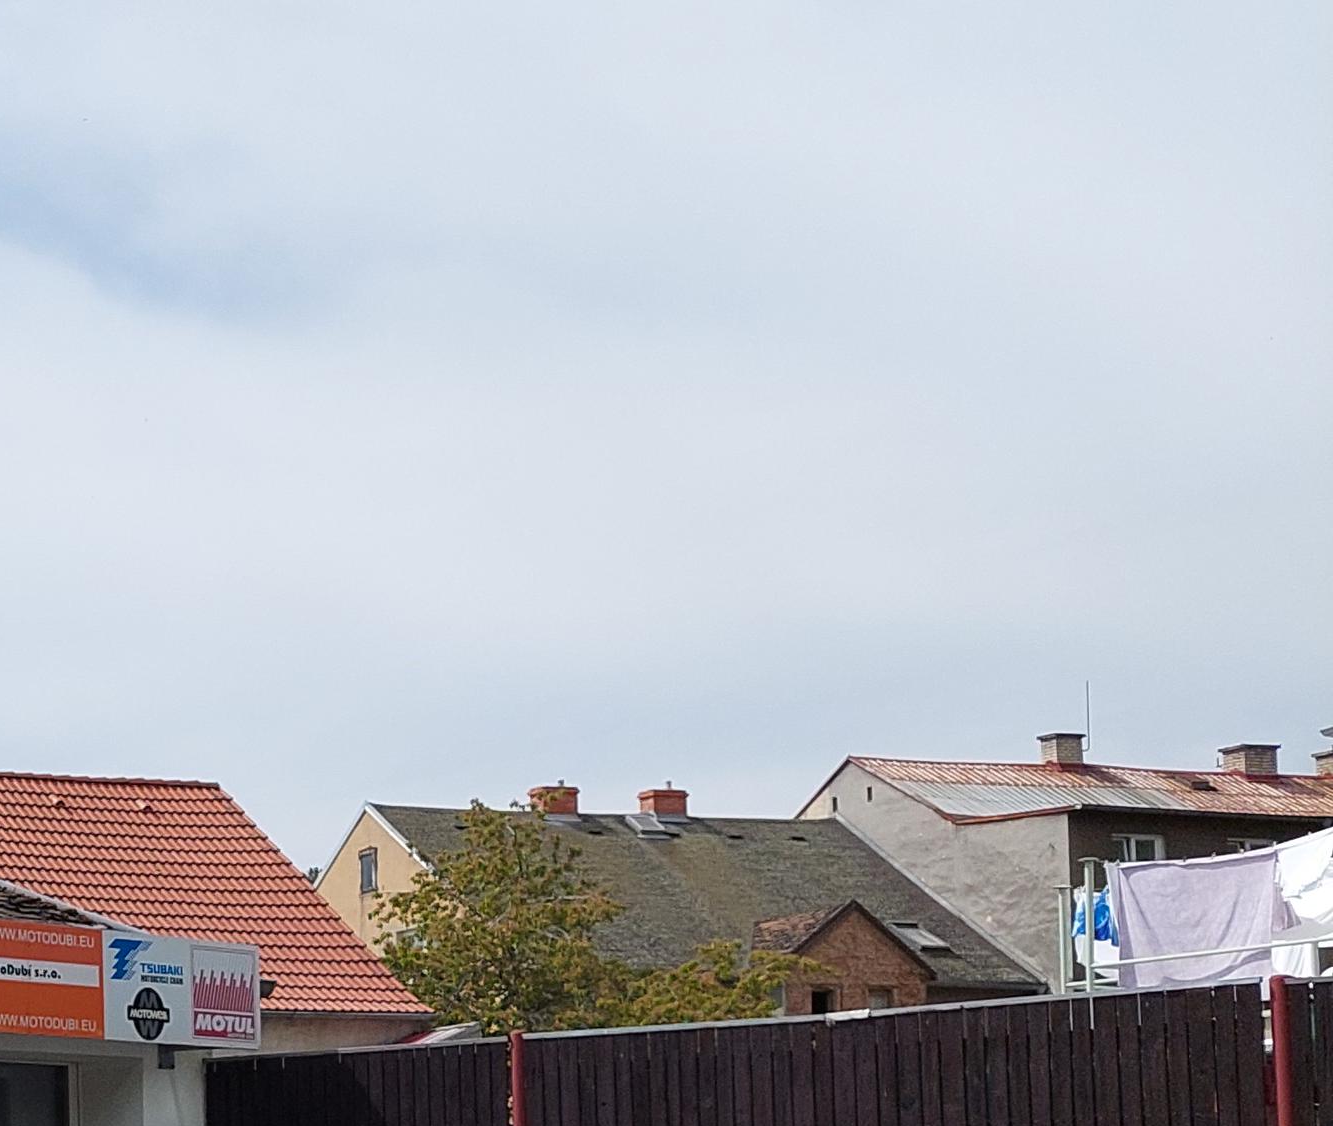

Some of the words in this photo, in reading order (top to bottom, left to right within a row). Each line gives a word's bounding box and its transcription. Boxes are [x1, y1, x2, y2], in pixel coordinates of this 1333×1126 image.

[34, 968, 61, 979] s.r.o.
[140, 963, 183, 976] TSUBAKI
[196, 1013, 254, 1034] MOTUL
